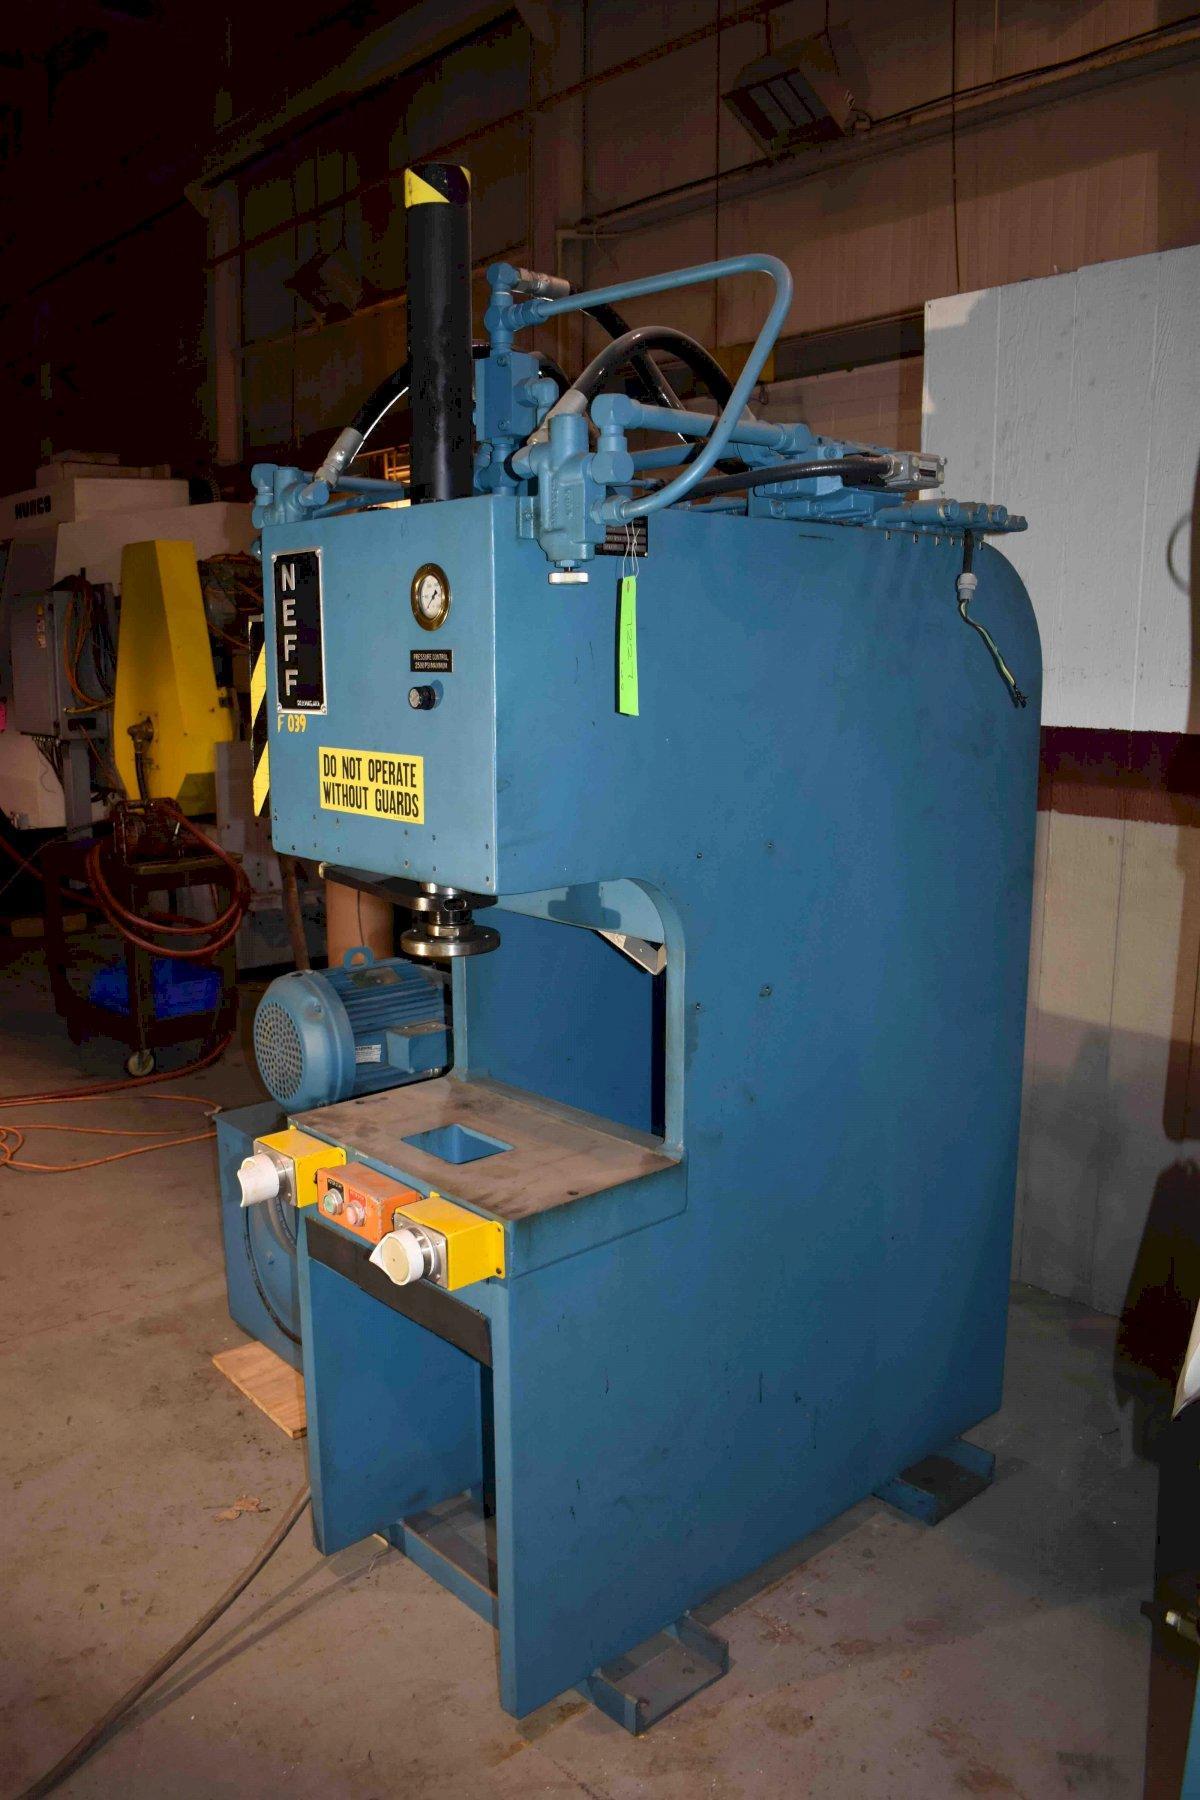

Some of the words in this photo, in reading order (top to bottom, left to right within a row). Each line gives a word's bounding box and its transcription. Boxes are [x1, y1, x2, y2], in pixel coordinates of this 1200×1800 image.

[14, 496, 52, 520] HURCO
[281, 563, 299, 697] NEFF
[413, 653, 432, 661] PRESSURE
[277, 715, 285, 733] F
[287, 714, 307, 733] 039
[323, 754, 337, 777] DO
[342, 756, 362, 781] NOT
[368, 759, 417, 788] OPERATE
[323, 782, 369, 810] WITHOUT
[375, 789, 419, 817] GUARDS
